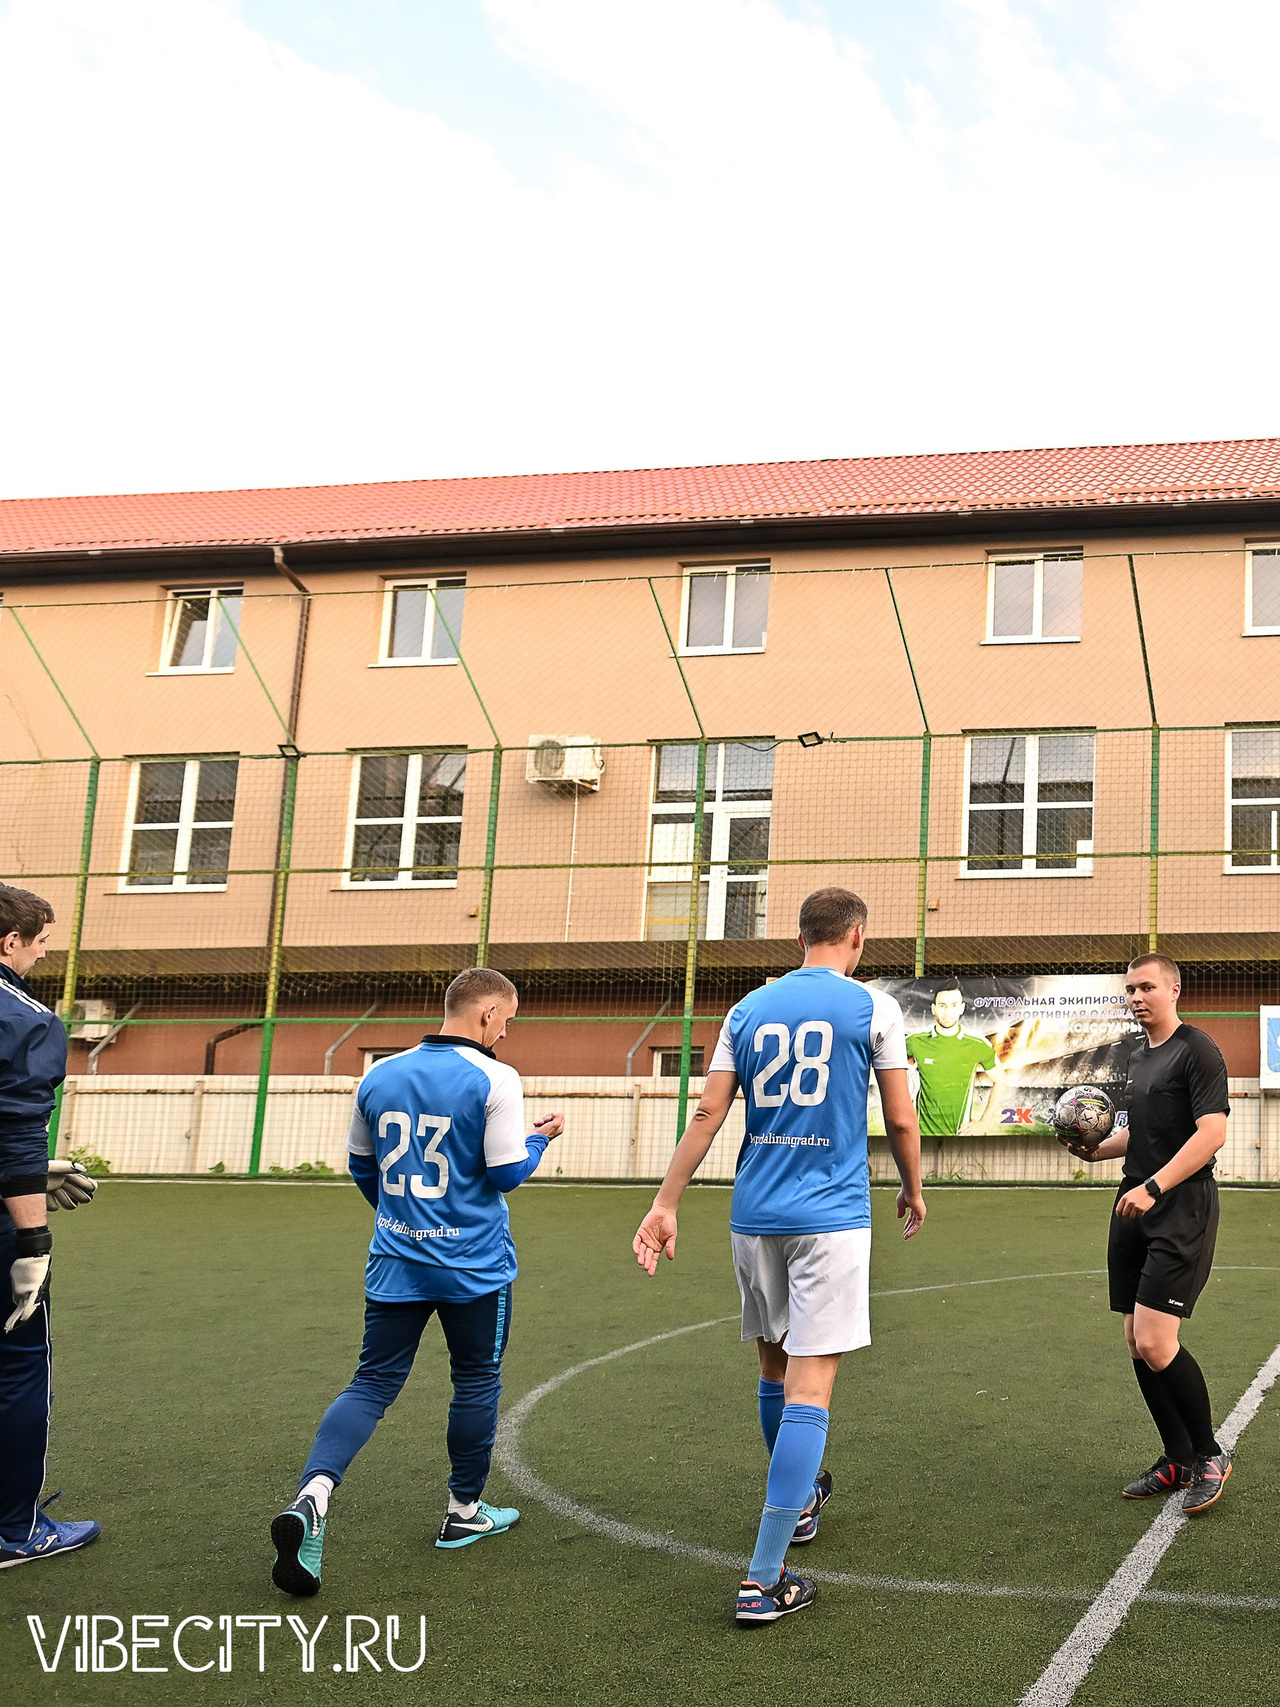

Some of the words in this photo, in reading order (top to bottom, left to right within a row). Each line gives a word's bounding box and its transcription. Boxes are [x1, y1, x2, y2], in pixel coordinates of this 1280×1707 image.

[974, 996, 1055, 1007] ФУТБОЛЬНАЯ
[1005, 1009, 1086, 1020] СПОРТИВНАЯ
[752, 1020, 834, 1108] 28
[1000, 1108, 1034, 1123] 2K
[378, 1110, 452, 1199] 23
